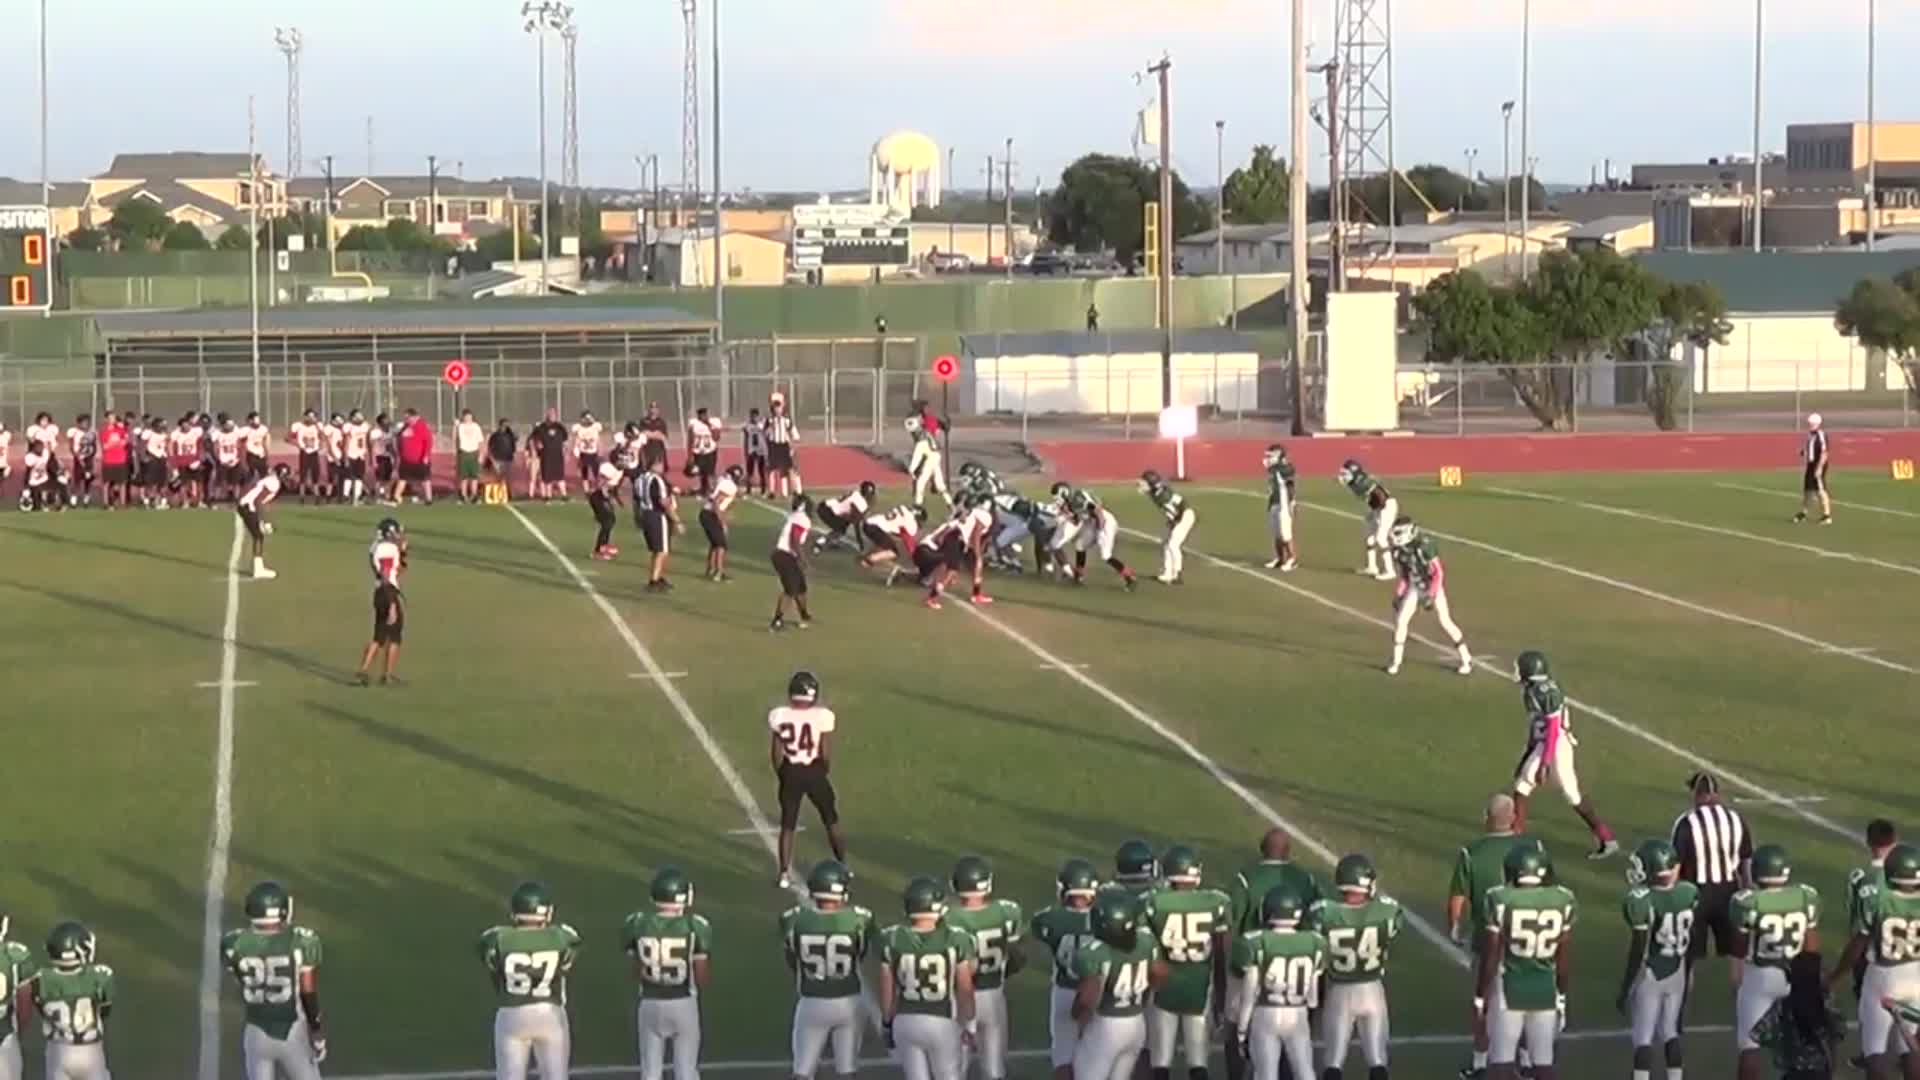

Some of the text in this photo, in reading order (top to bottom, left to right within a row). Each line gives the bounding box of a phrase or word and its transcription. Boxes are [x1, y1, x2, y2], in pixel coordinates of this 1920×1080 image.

[779, 722, 814, 758] 24
[976, 928, 1003, 974] 5
[1161, 911, 1213, 962] 45
[1328, 927, 1382, 973] 54
[1509, 910, 1563, 959] 52
[1655, 909, 1694, 957] 48
[1756, 911, 1807, 959] 23
[239, 955, 292, 1003] 25
[504, 950, 559, 998] 67
[801, 934, 853, 981] 56
[898, 953, 948, 1001] 43
[1265, 956, 1309, 1005] 40
[1113, 959, 1149, 1008] 44
